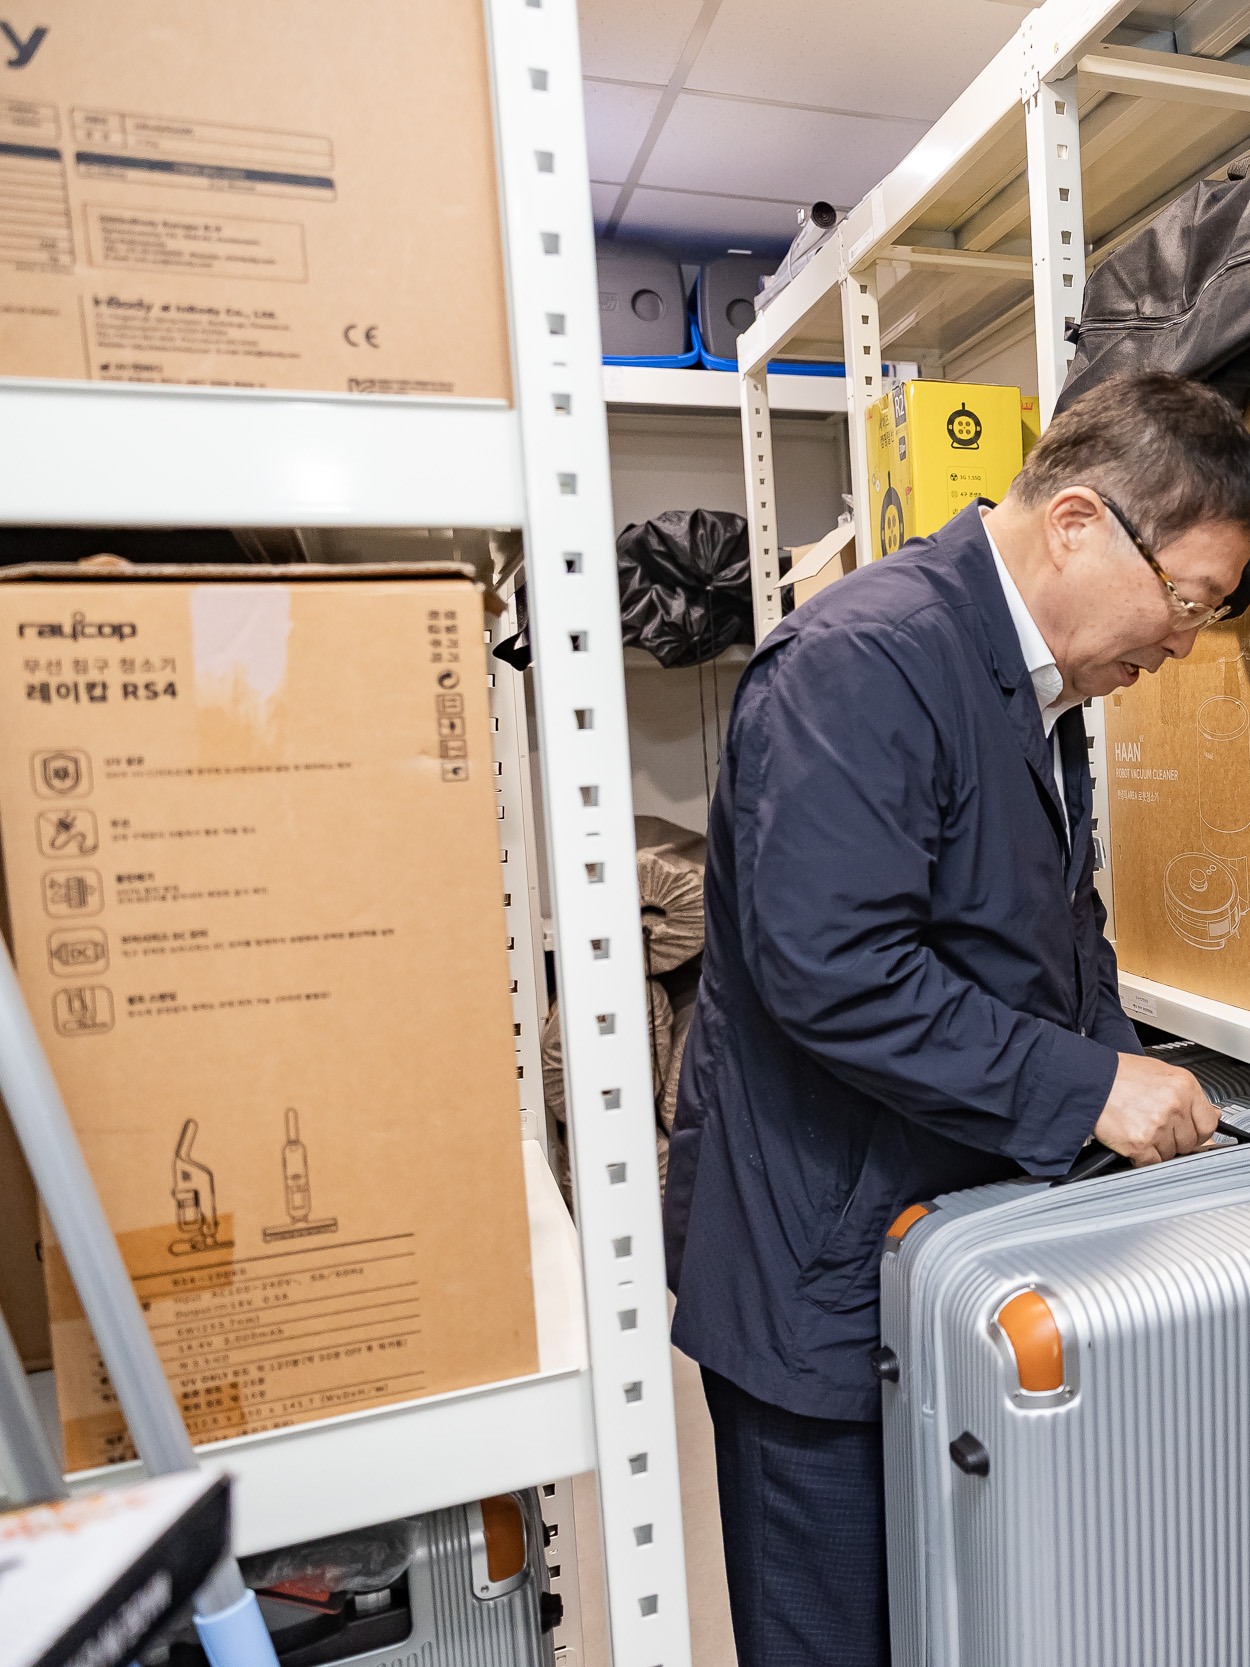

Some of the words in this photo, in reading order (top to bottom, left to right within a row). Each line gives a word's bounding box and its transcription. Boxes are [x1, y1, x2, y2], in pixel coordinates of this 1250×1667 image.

[894, 396, 905, 419] R2
[18, 611, 138, 641] raycop
[121, 680, 178, 701] RS4
[1114, 742, 1141, 762] HAAN
[1115, 768, 1131, 779] ROBOT
[1131, 769, 1152, 780] VACUUM
[1152, 769, 1179, 781] CLEANER
